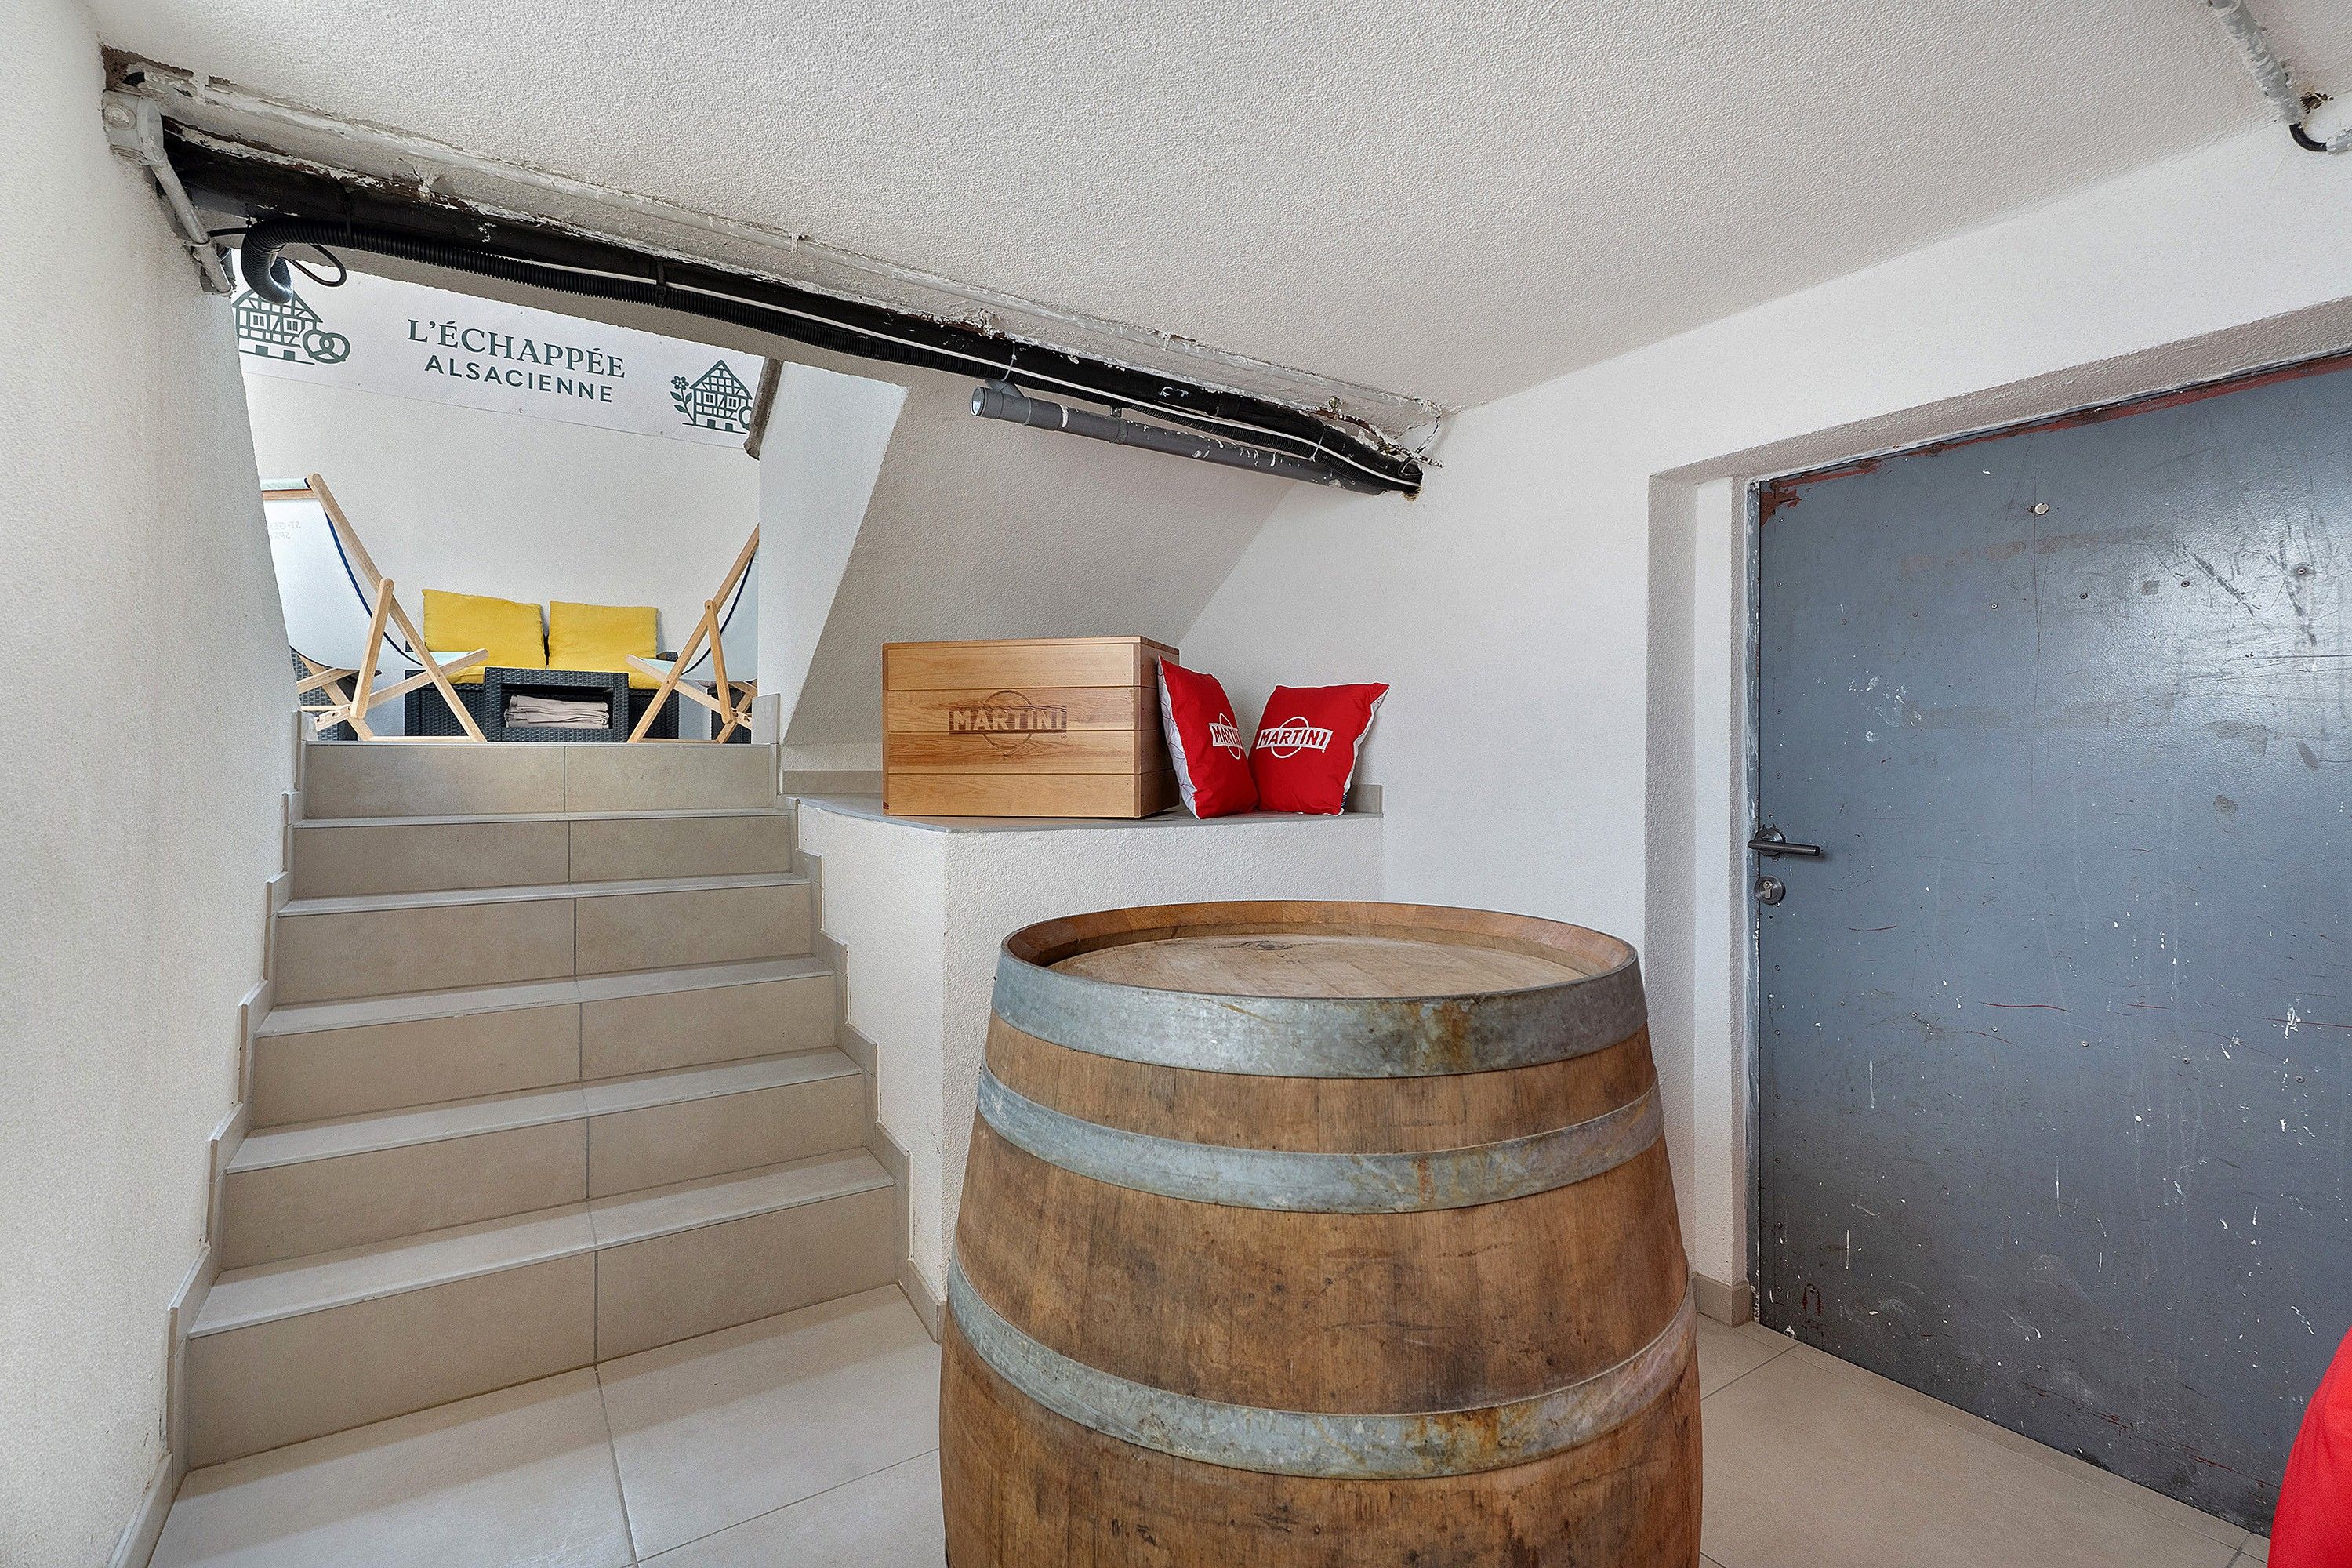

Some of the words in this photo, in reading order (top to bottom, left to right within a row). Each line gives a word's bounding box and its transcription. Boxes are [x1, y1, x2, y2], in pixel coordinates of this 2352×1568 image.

[423, 354, 612, 403] ALSACIENNE
[952, 707, 1063, 731] MARTINI
[1259, 729, 1329, 747] MARTINI
